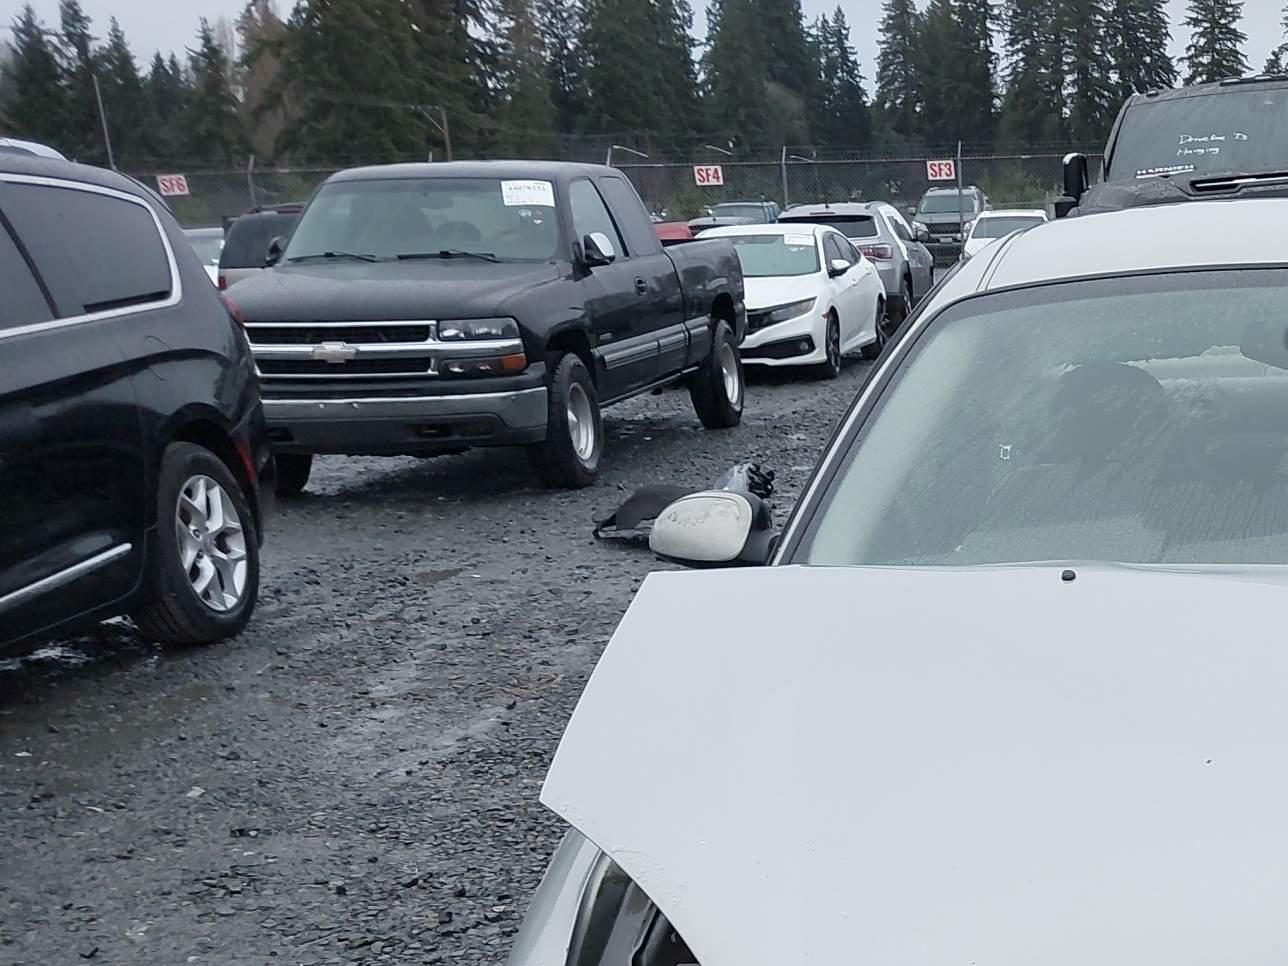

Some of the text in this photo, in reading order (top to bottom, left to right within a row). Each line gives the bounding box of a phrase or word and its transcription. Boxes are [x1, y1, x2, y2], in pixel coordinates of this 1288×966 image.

[697, 168, 721, 183] SF4
[930, 162, 953, 178] SF3
[160, 177, 186, 192] SF6
